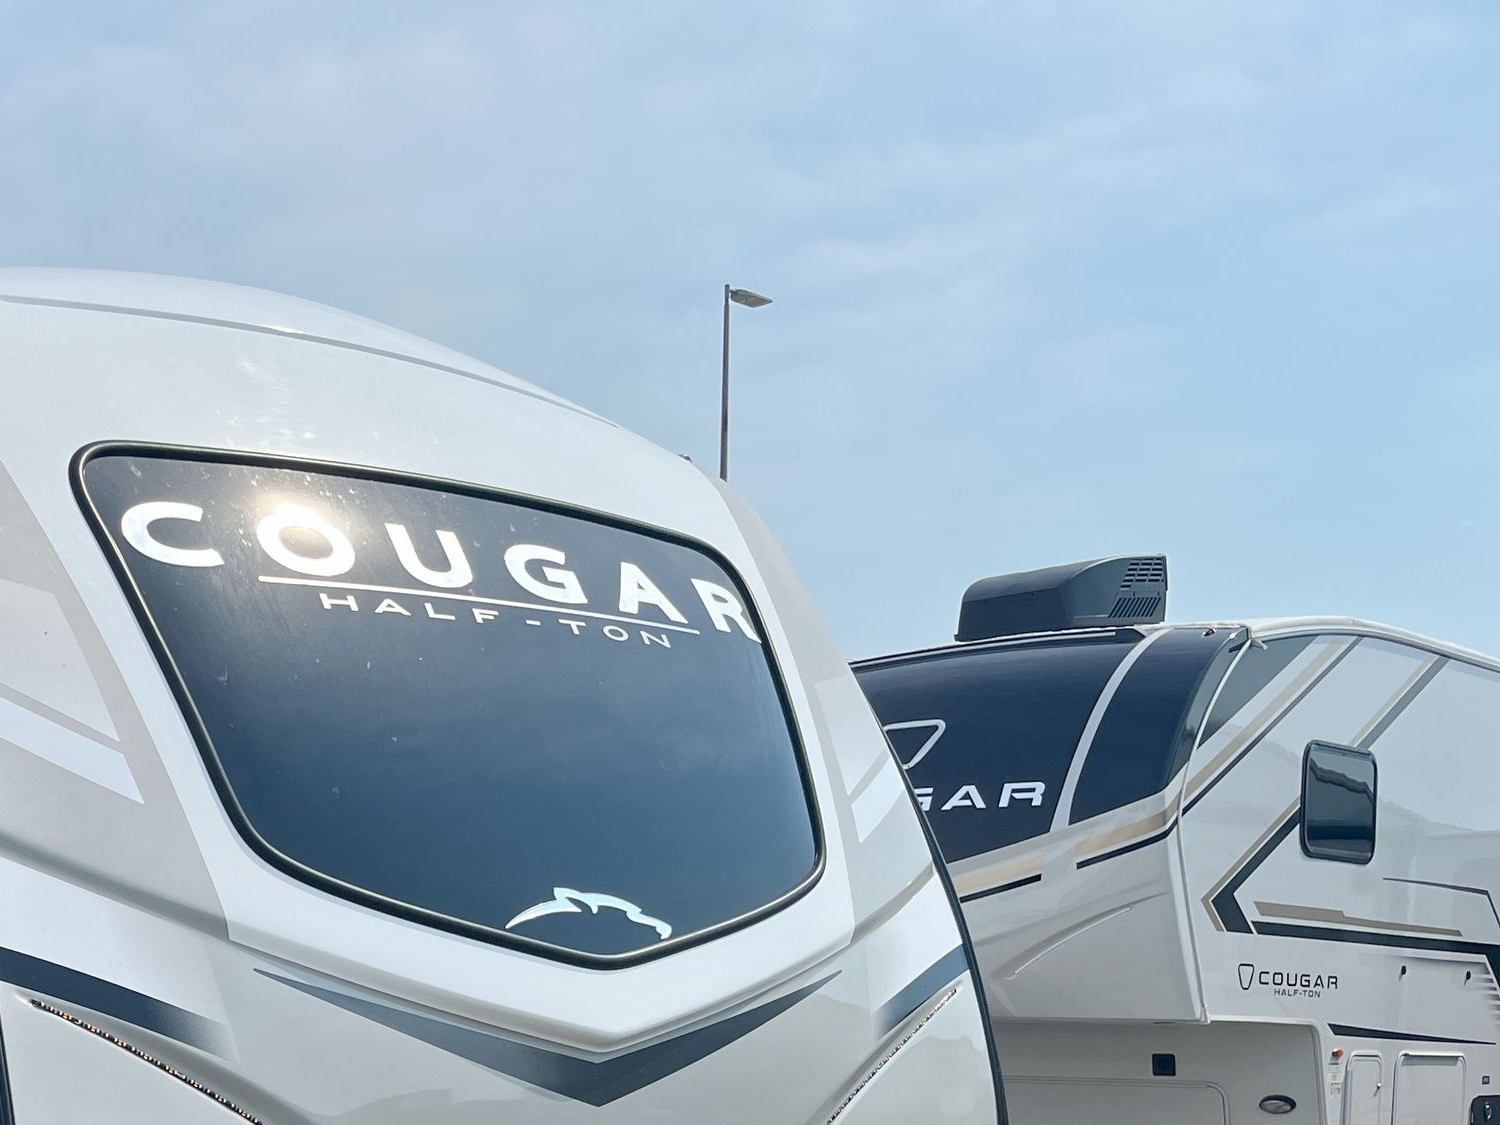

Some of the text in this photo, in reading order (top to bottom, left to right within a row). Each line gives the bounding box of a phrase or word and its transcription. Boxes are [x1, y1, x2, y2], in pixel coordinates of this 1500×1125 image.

[120, 501, 762, 643] COUGAR
[322, 593, 672, 649] HALF-TON
[1258, 970, 1339, 990] COUGAR
[1273, 988, 1321, 999] HALF-TON
